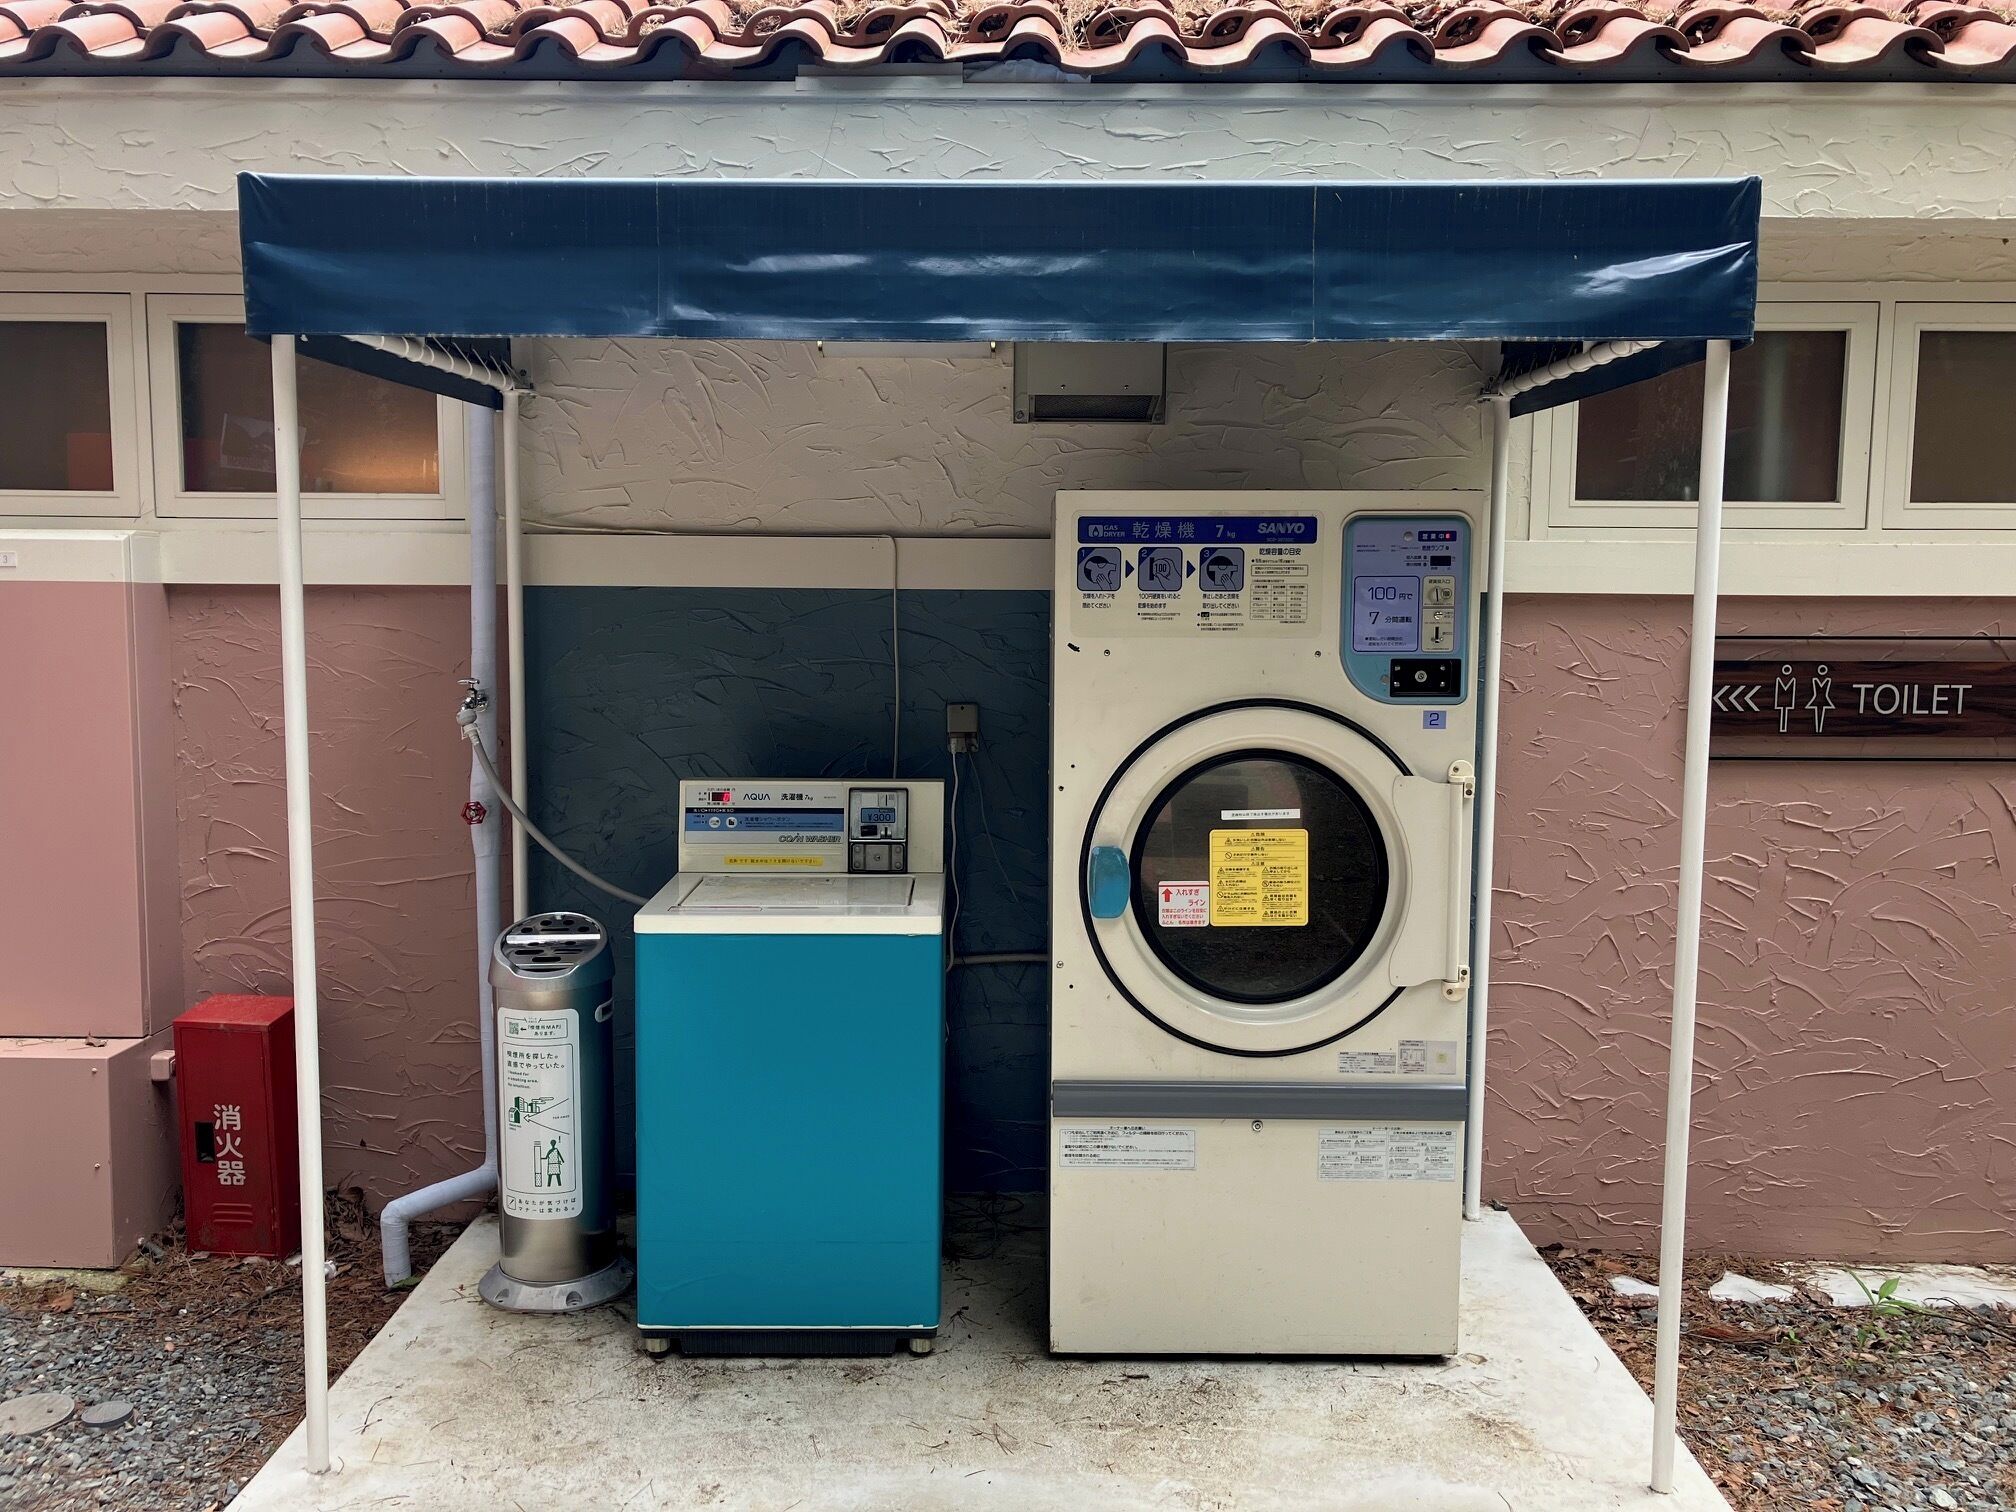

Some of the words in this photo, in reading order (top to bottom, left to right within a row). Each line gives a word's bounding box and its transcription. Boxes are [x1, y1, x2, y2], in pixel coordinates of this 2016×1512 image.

[1132, 522, 1195, 538] 乾燥機
[1215, 525, 1225, 538] 7
[1257, 522, 1305, 534] SANYO
[1154, 563, 1167, 573] 100
[1368, 586, 1397, 600] 100
[1369, 611, 1380, 625] 7
[1852, 684, 1973, 715] TOILET
[1429, 713, 1440, 726] 2
[743, 793, 771, 801] AQUA
[780, 793, 803, 801] 洗濯機
[868, 813, 891, 822] ¥300
[1188, 899, 1206, 907] ライン
[213, 1103, 246, 1186] 消火器
